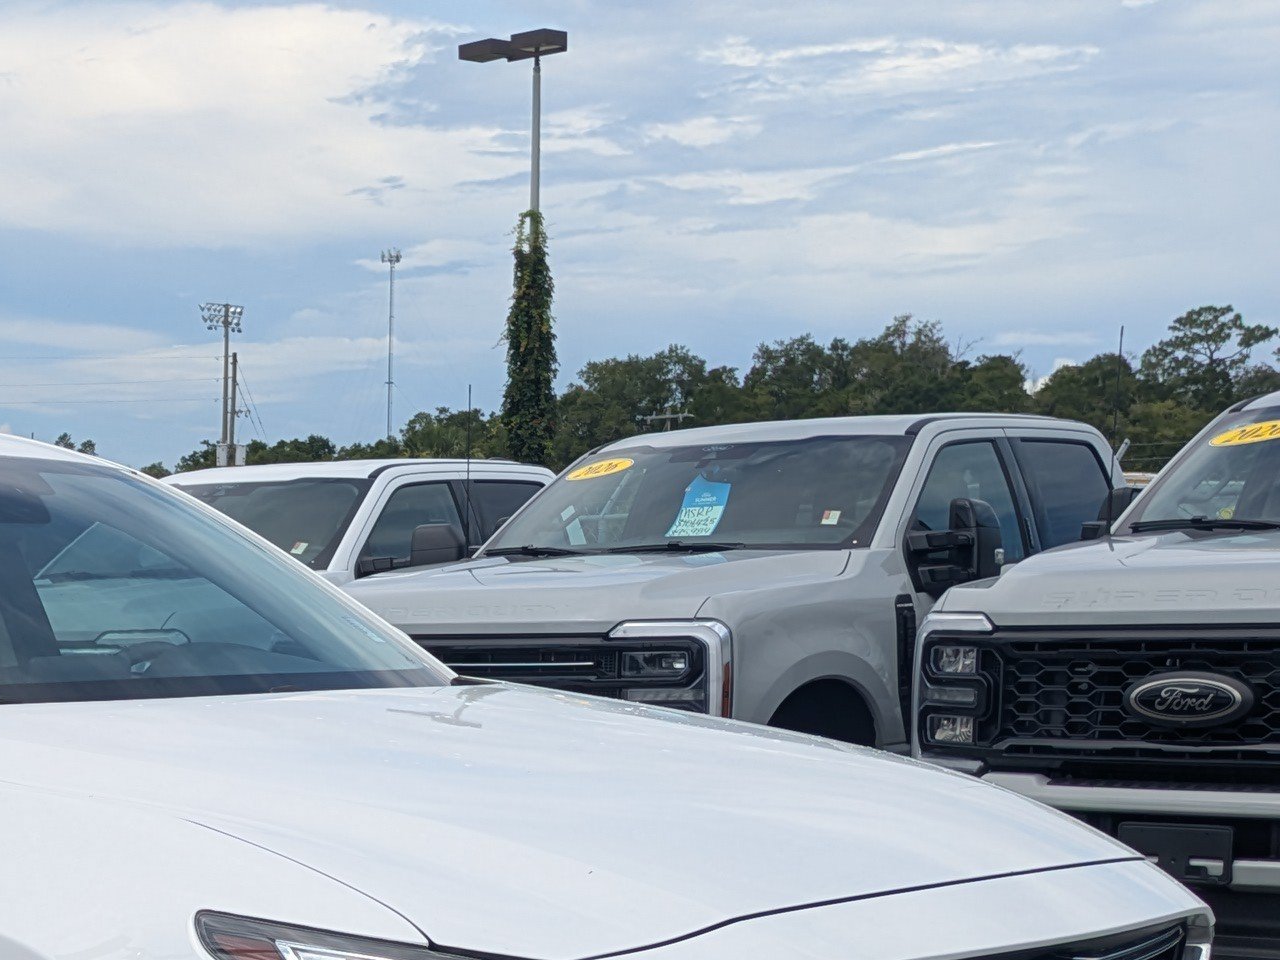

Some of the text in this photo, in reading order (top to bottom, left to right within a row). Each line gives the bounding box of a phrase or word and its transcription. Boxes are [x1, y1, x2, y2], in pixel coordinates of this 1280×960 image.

[680, 506, 713, 518] MSRP
[1041, 587, 1219, 608] SUPER
[1154, 686, 1216, 711] Ford
